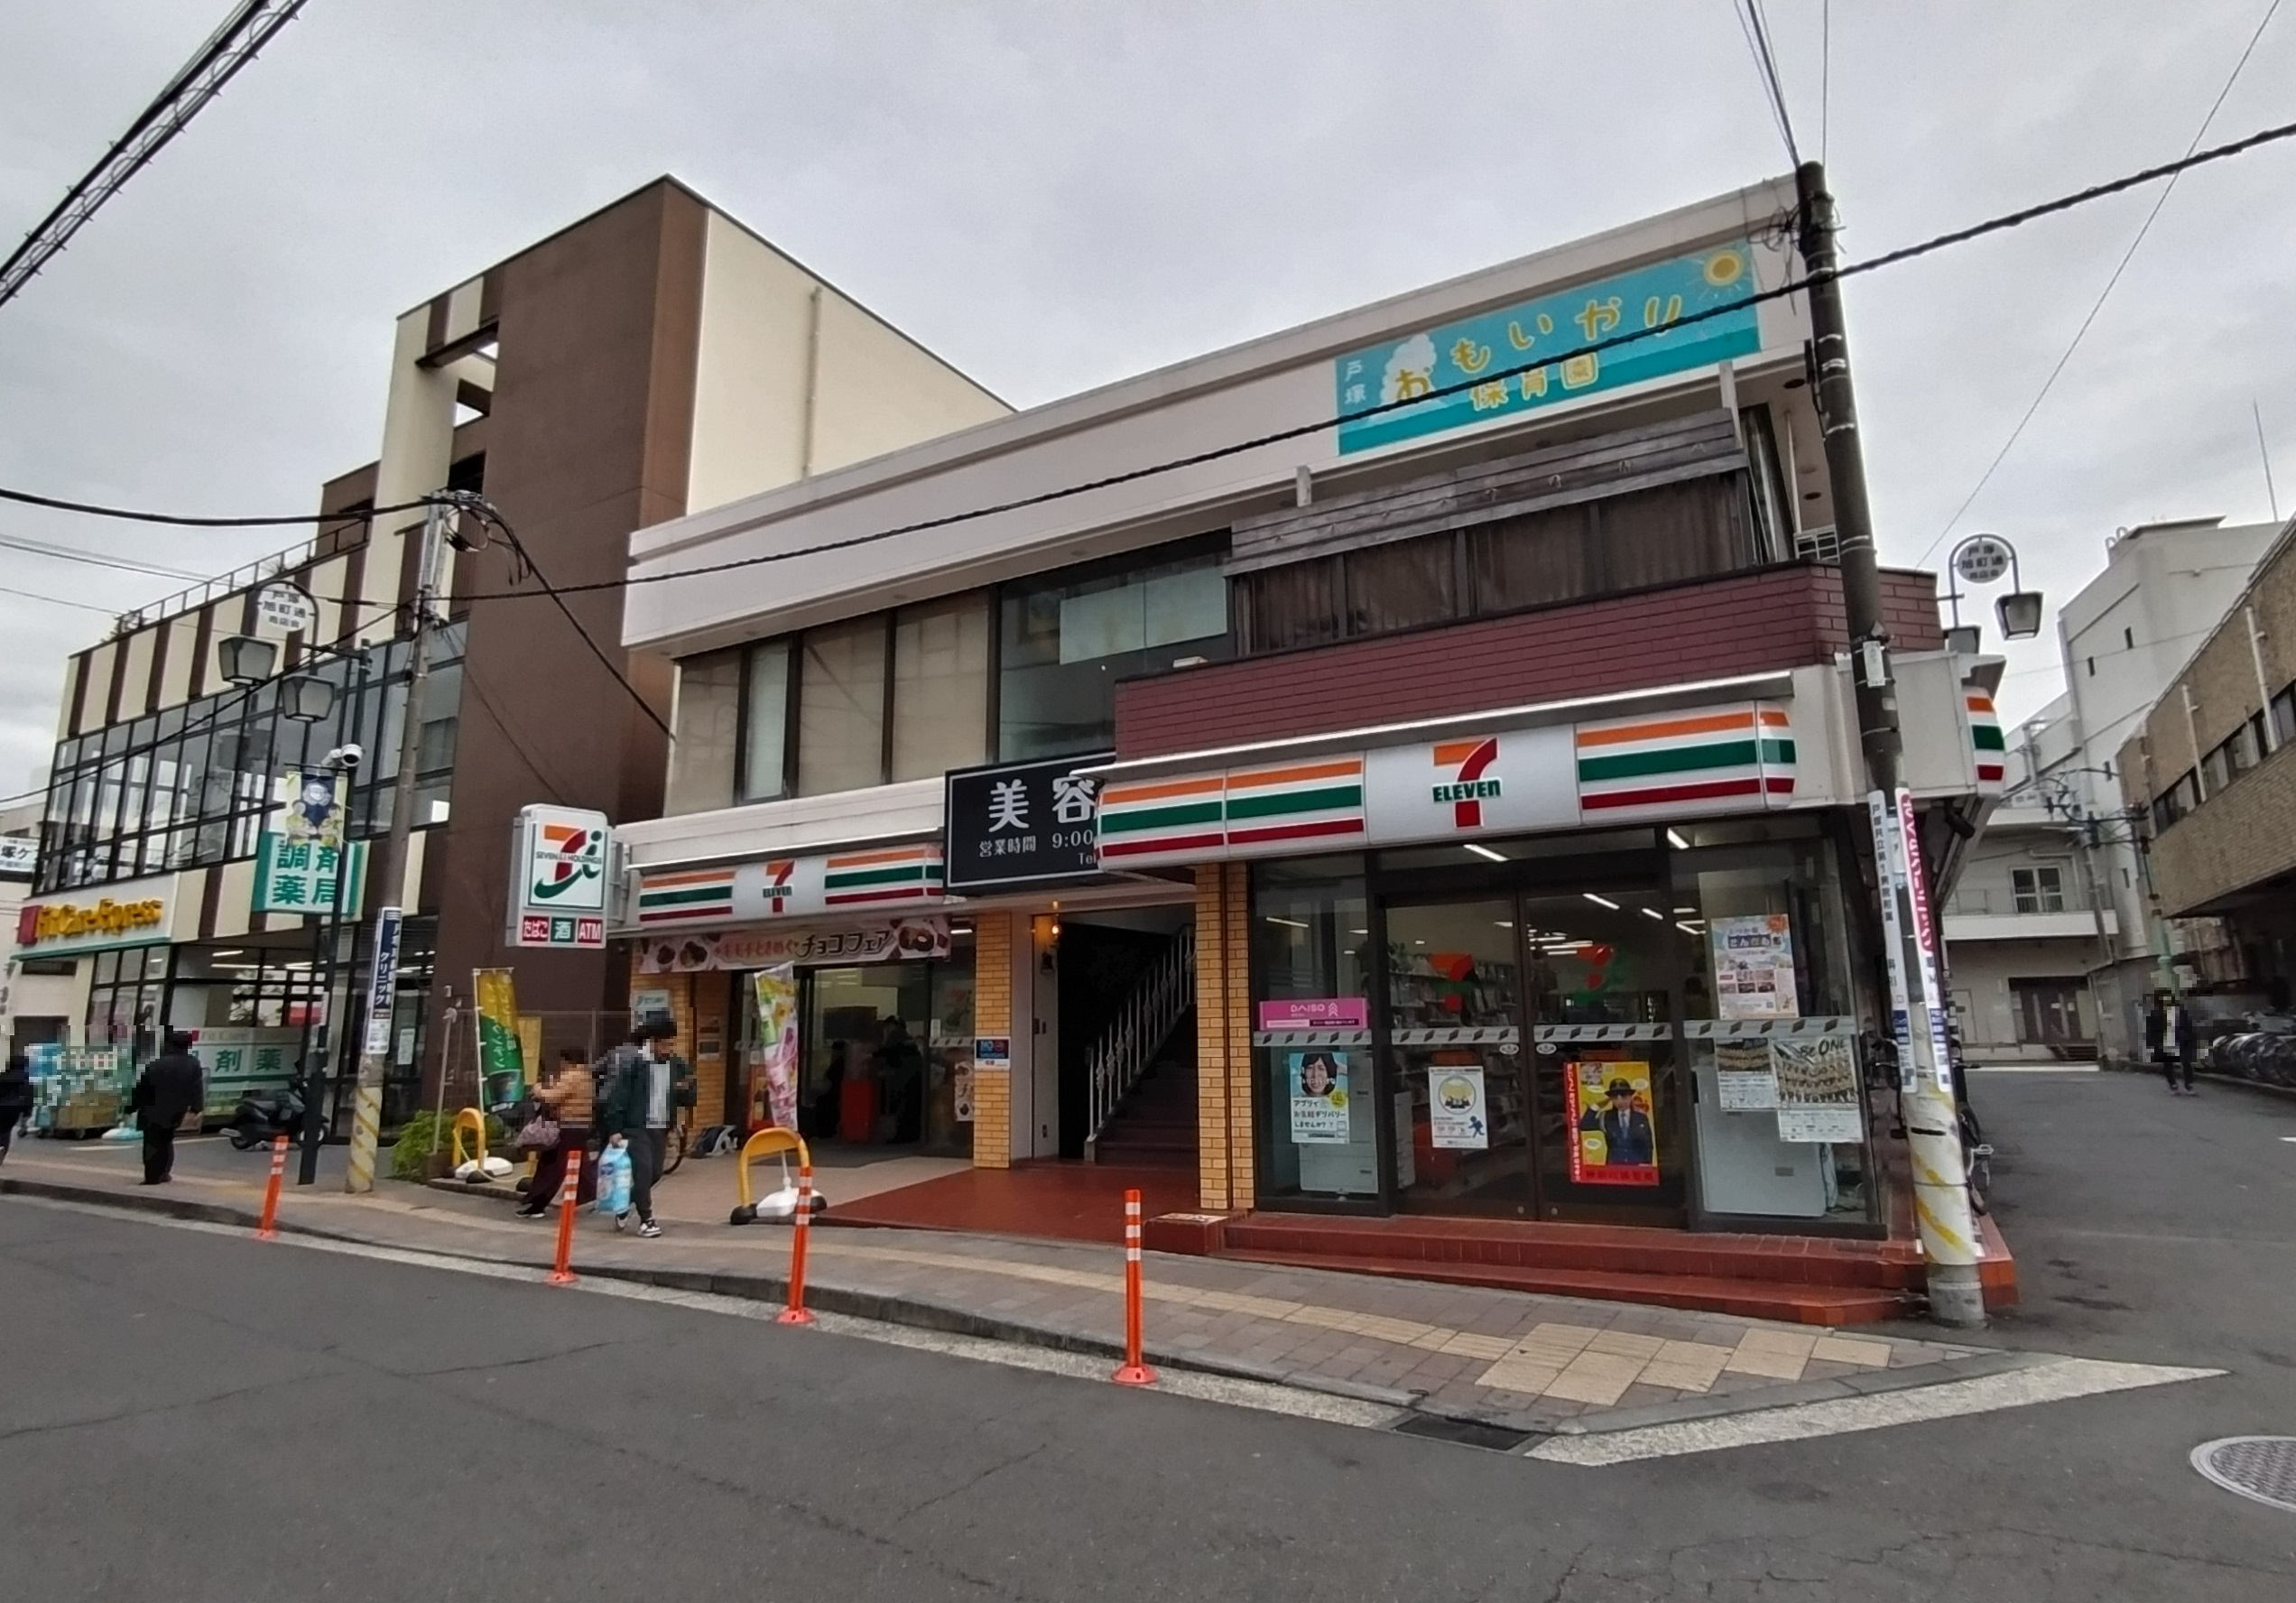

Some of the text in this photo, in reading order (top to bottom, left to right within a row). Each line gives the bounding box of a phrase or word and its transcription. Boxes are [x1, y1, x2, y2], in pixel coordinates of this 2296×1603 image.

[1395, 295, 1682, 403] おもいやり
[1344, 361, 1366, 404] 戸塚
[1470, 351, 1599, 411] 保育園
[988, 775, 1097, 833] 美容
[979, 835, 1037, 857] 営業時間
[273, 874, 338, 905] 薬局
[523, 919, 602, 940] たばこ 酒 ATM
[796, 930, 891, 959] チョコフェア
[375, 951, 390, 1005] クリニック
[1291, 1004, 1325, 1013] DAISO
[191, 1048, 283, 1072] 剤薬
